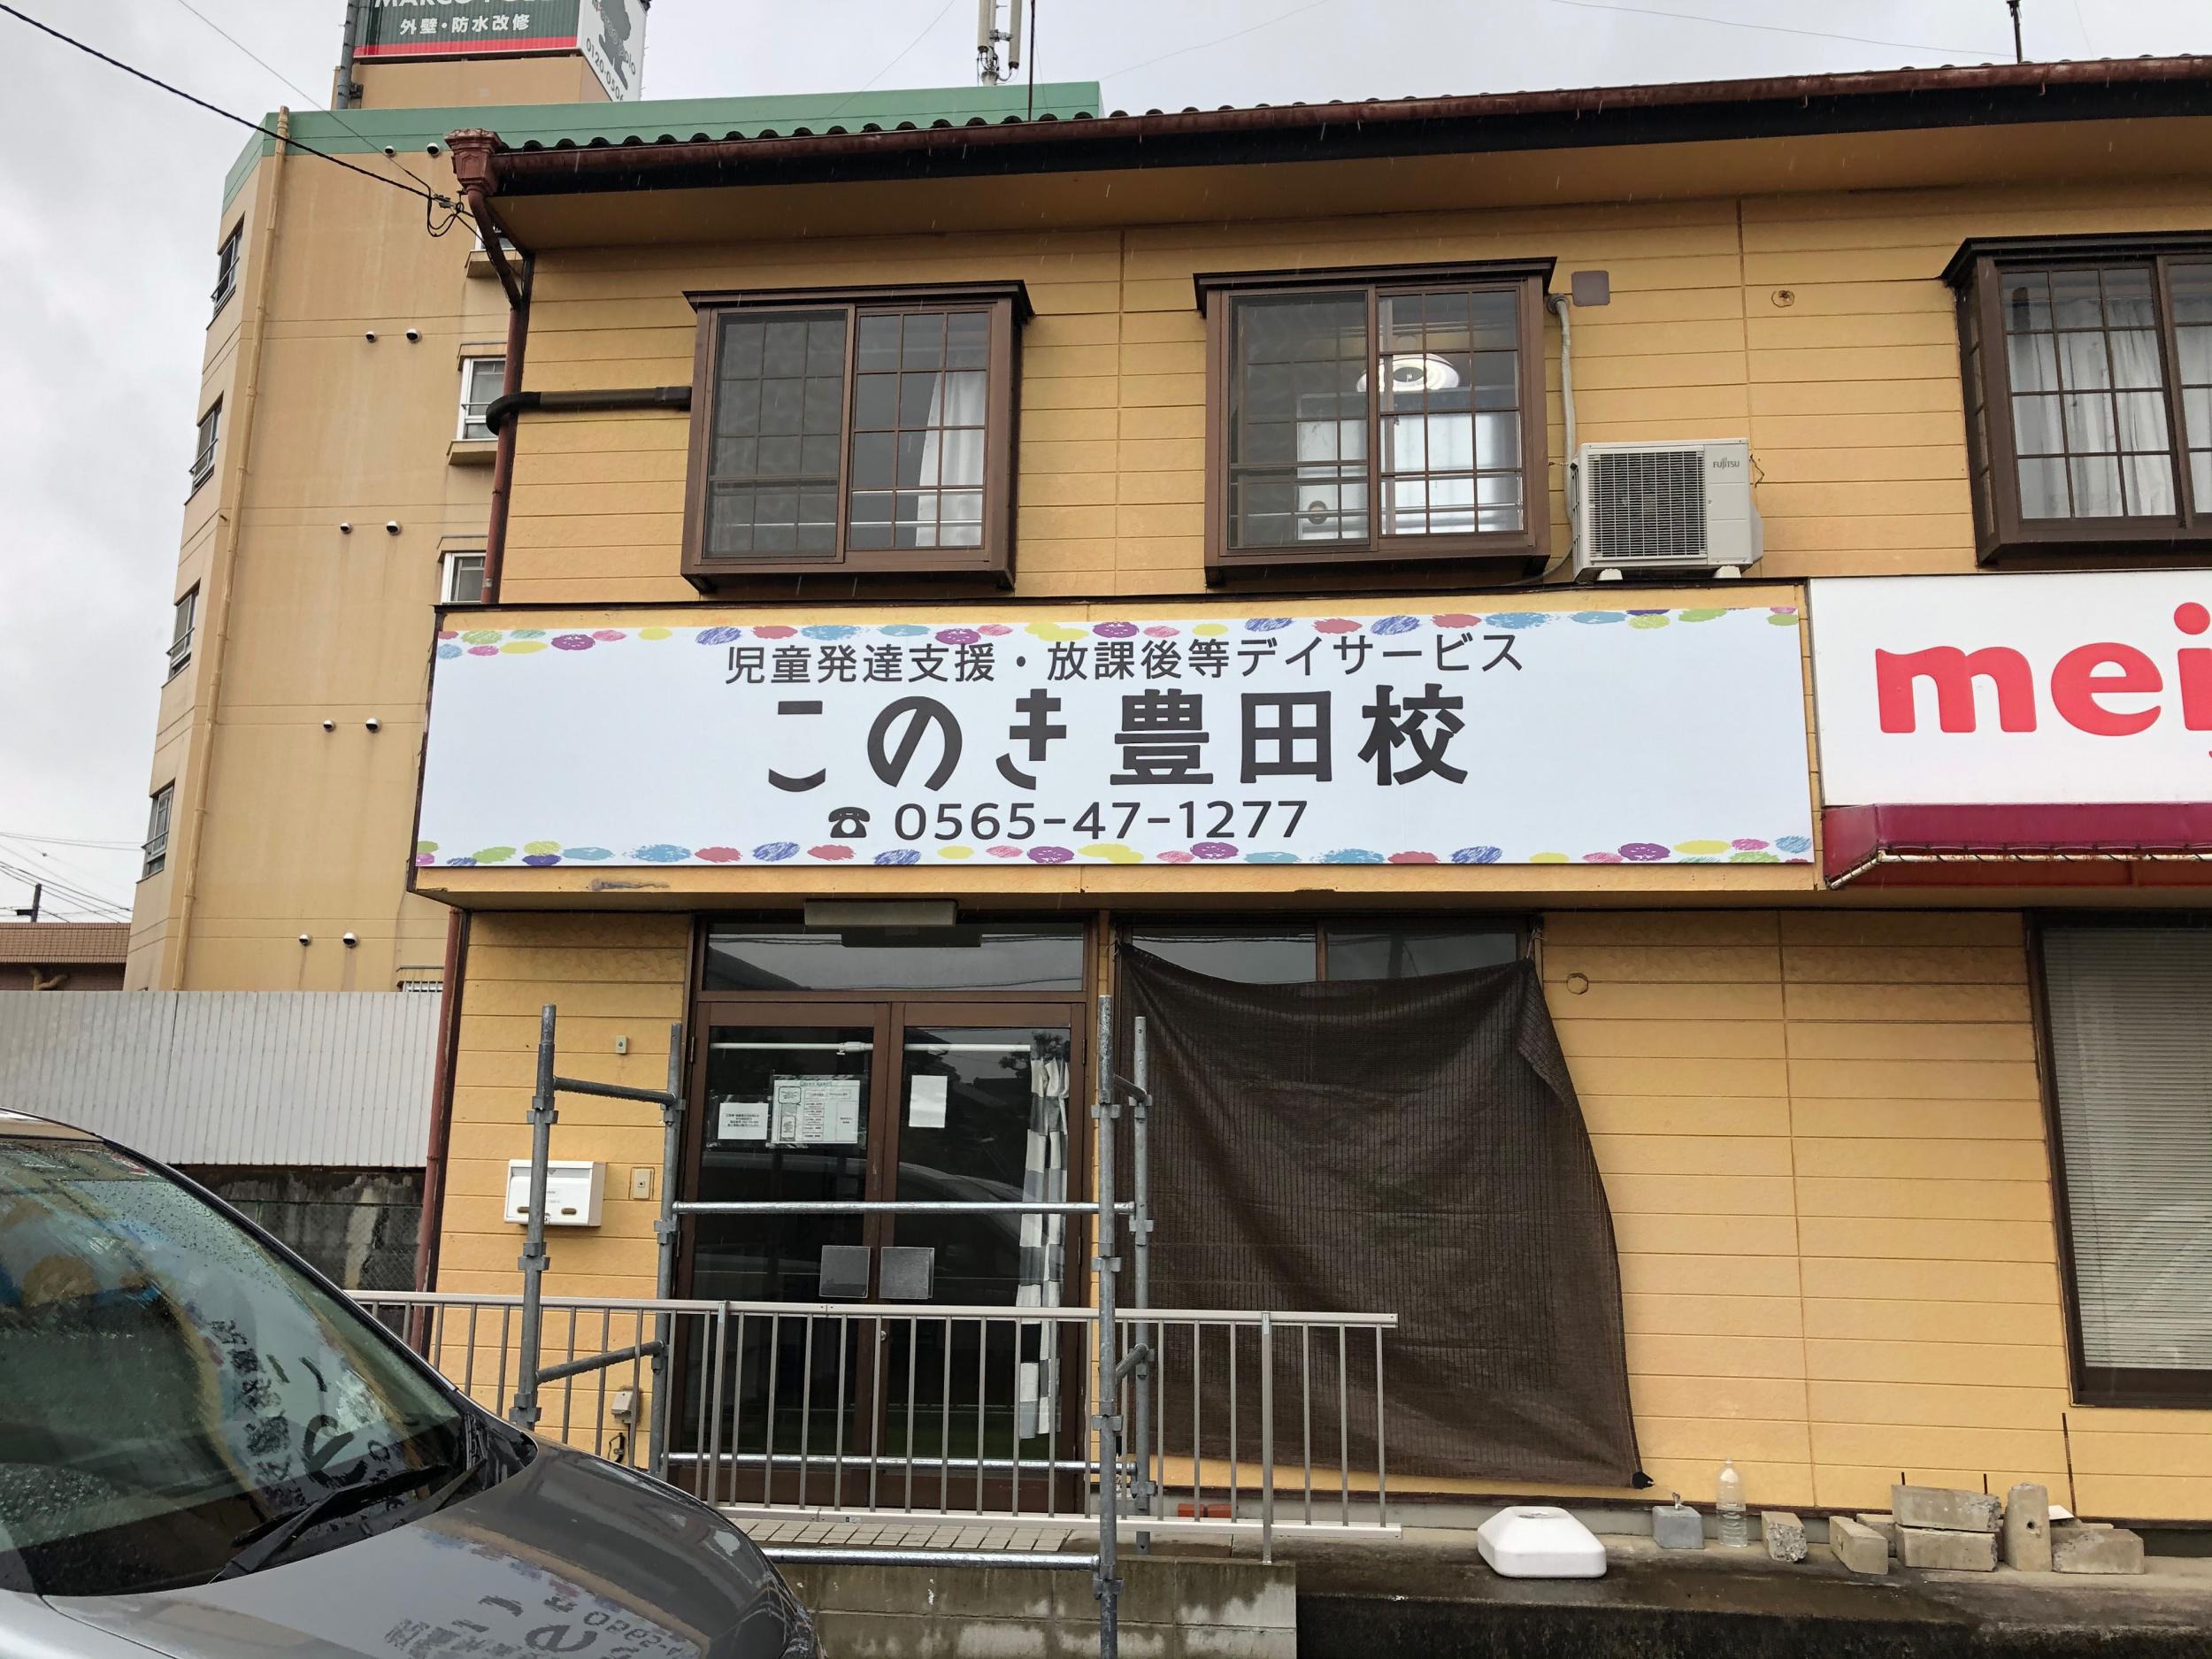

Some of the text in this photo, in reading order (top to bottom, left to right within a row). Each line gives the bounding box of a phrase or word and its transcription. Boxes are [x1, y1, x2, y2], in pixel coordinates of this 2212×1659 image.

[400, 13, 530, 35] 外壁・防水改修
[1713, 459, 1740, 469] FUJITSU
[726, 634, 1523, 684] 児童発達支援・放課後等デイサービス
[1876, 602, 2212, 758] mei
[768, 683, 1468, 792] このき豊田校
[895, 800, 1307, 840] 0565-47-1277
